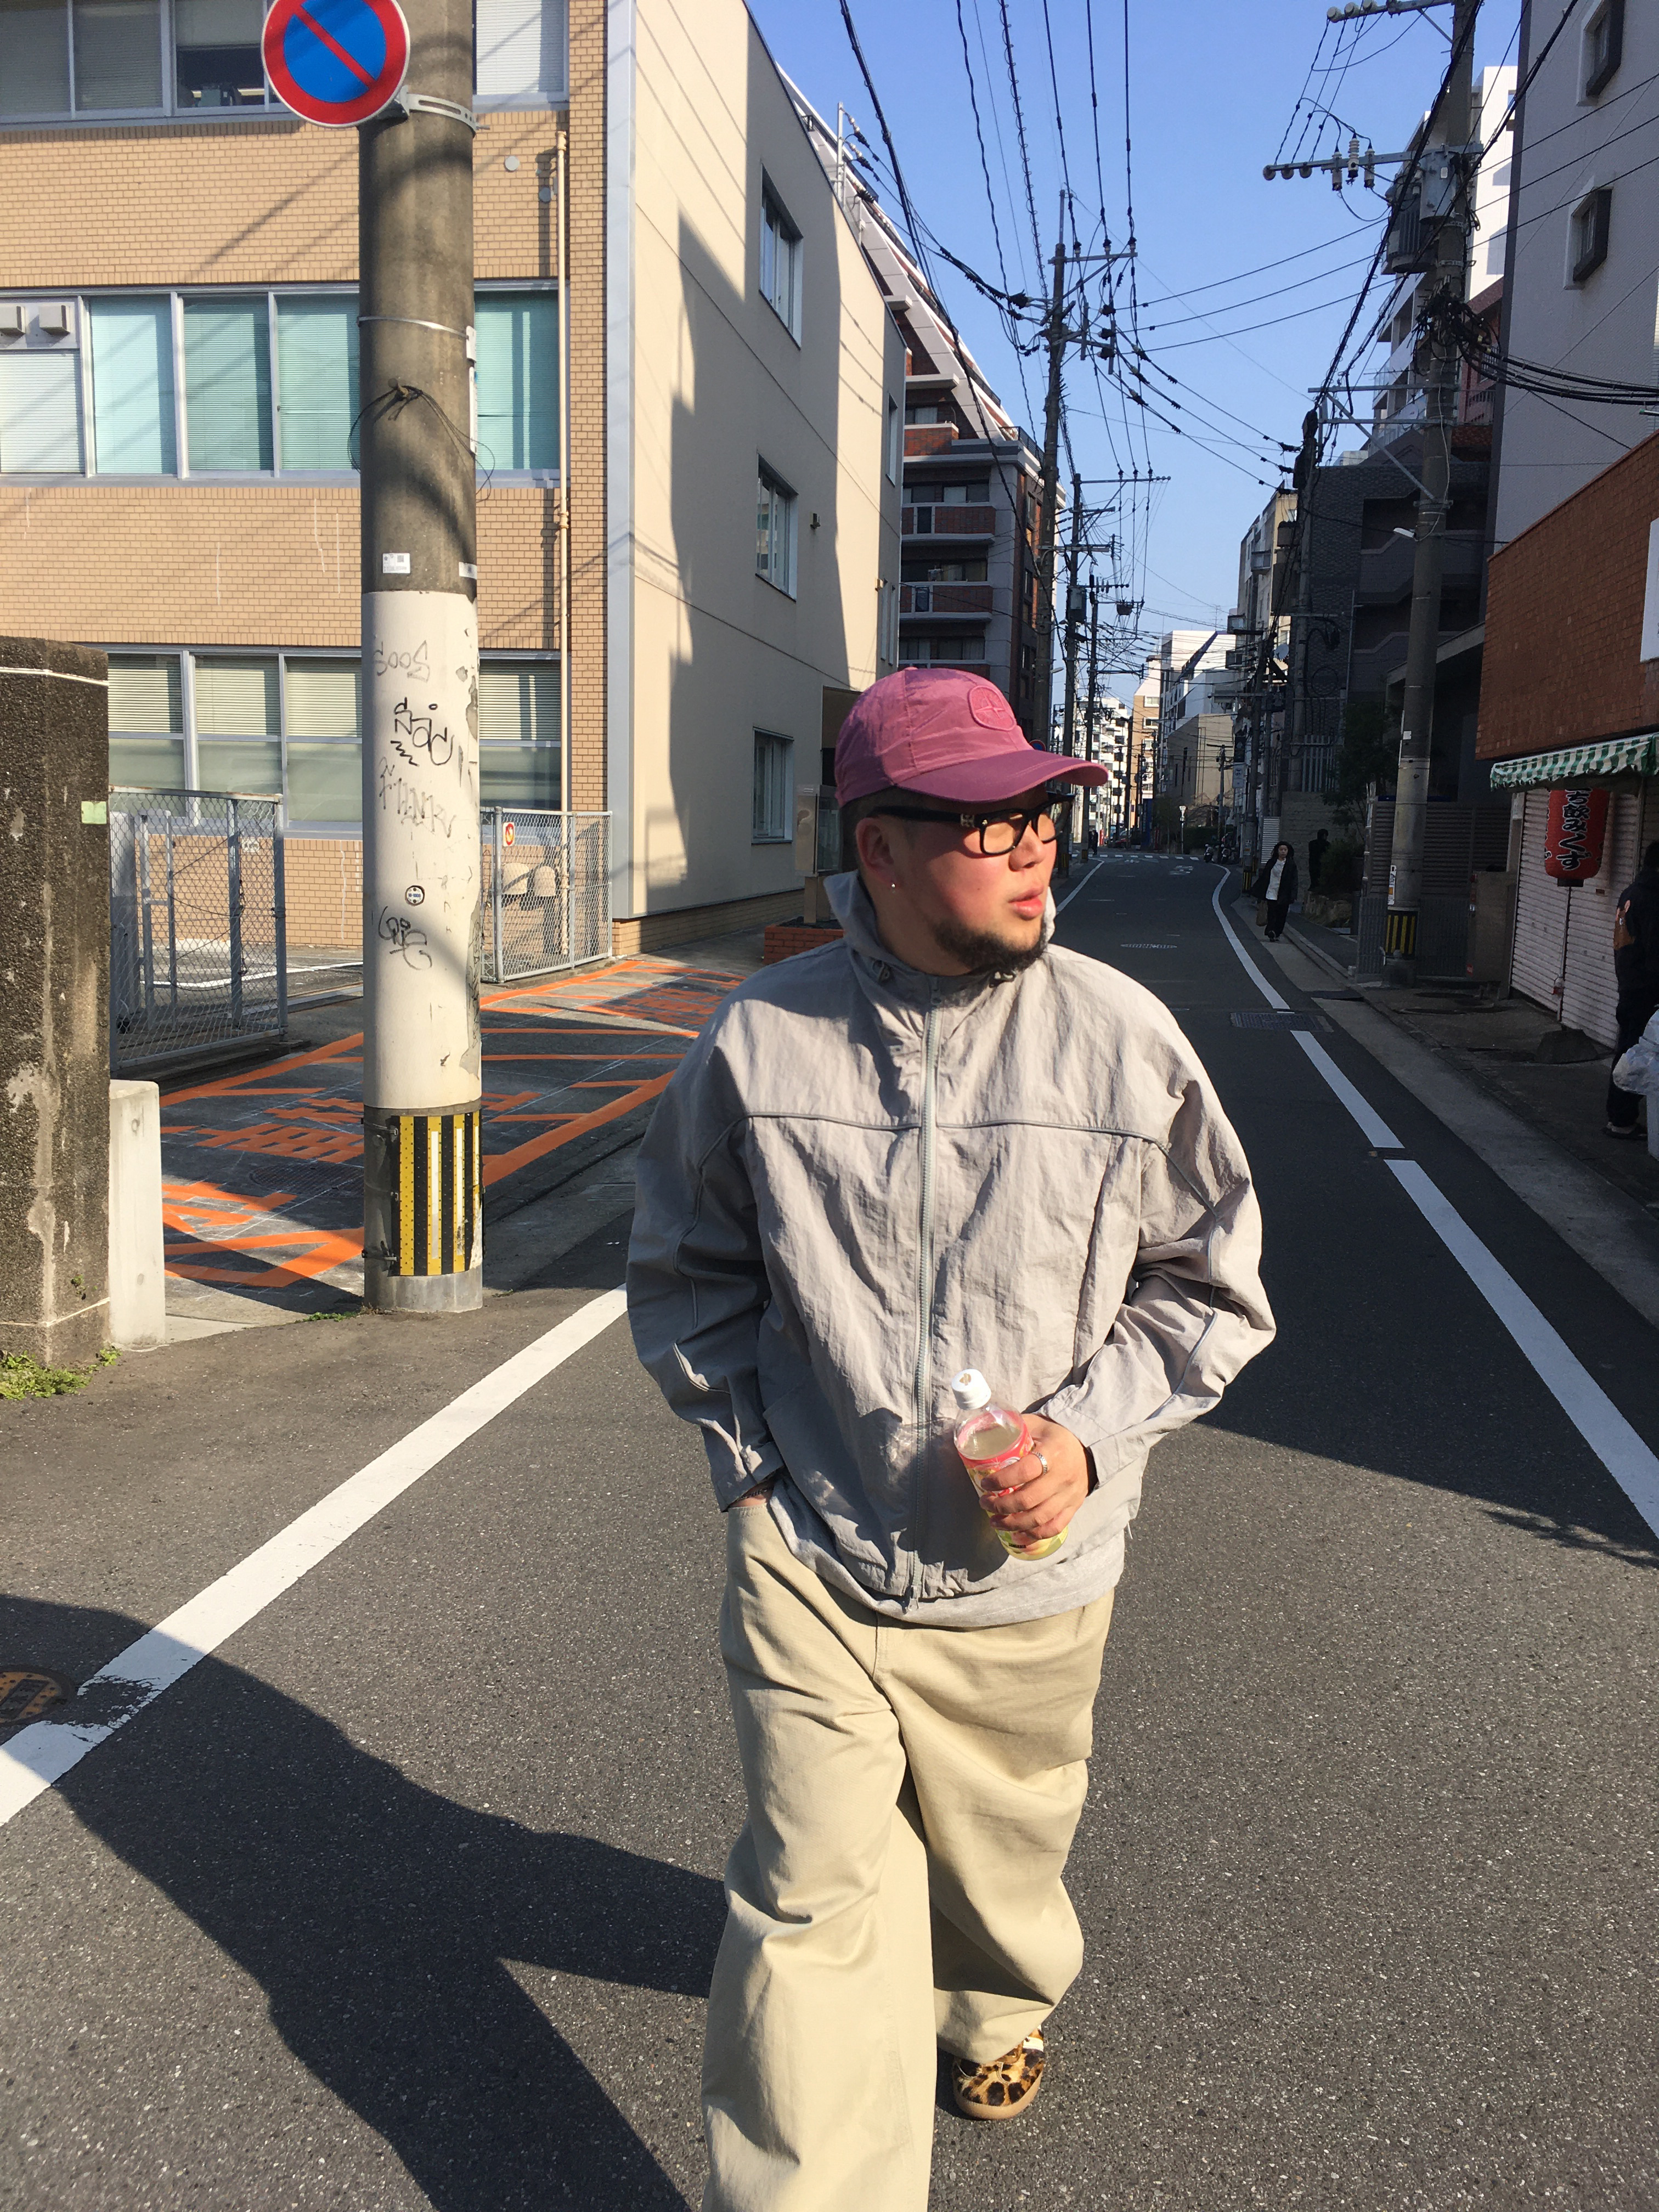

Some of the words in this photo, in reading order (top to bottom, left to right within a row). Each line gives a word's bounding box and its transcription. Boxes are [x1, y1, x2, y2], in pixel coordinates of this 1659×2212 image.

[1556, 787, 1593, 871] ち飲みくず
